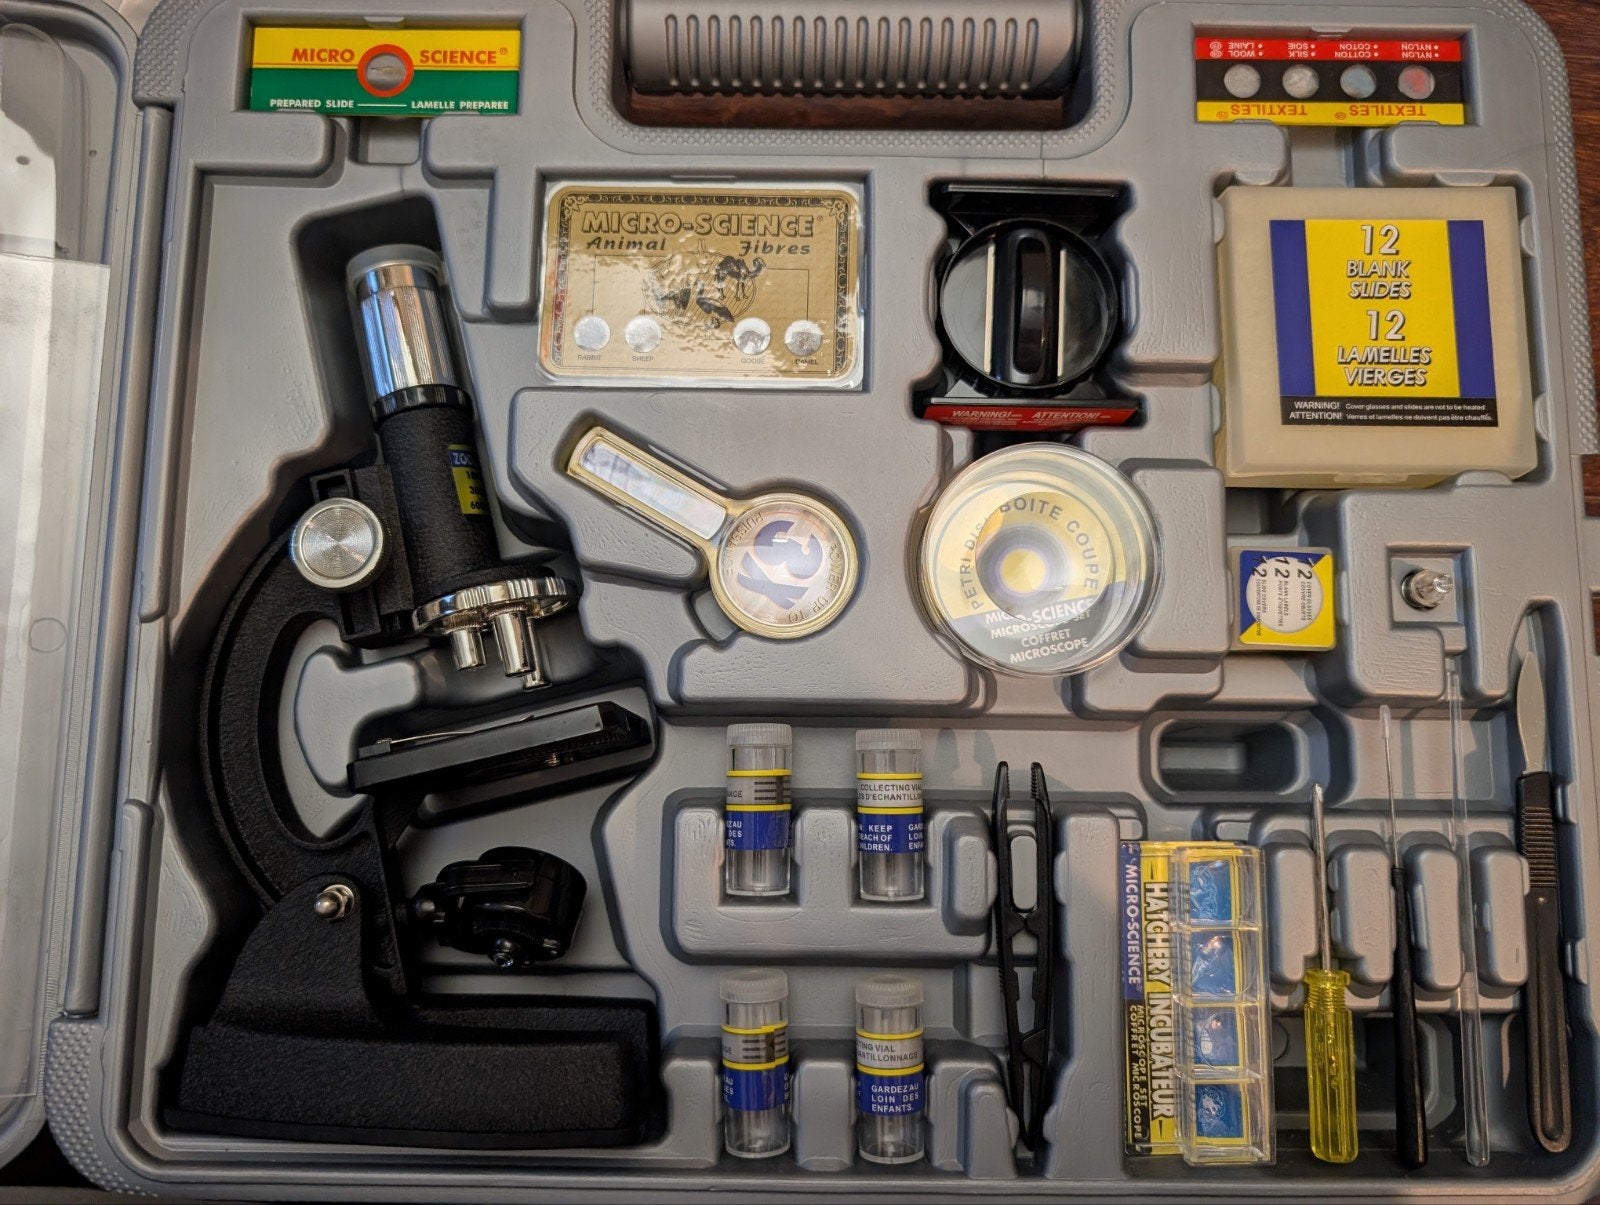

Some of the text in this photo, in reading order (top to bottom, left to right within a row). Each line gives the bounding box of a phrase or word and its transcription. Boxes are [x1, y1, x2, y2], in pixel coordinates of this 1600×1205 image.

[291, 48, 355, 63] MICRO
[270, 99, 322, 108] PREPARED
[326, 100, 354, 108] SLIDE
[411, 100, 455, 109] LAMELLE
[1230, 104, 1308, 116] TEXTILES
[1349, 104, 1426, 117] TEXTILES
[586, 236, 810, 256] Animal Fibres
[1360, 224, 1400, 256] 12
[1346, 260, 1411, 278] BLANK
[1348, 280, 1412, 300] SLIDES
[1366, 310, 1406, 341] 12
[1336, 346, 1432, 365] LAMELLES
[1344, 368, 1427, 386] VIERGES
[1294, 401, 1340, 409] WARNING!
[1289, 411, 1342, 420] ATTENTION!
[1000, 497, 1099, 590] BOITE COUPE
[826, 543, 842, 592] POWER
[960, 517, 988, 610] PETRI DIS
[813, 595, 829, 613] UP
[1021, 629, 1071, 648] COFFRET
[1009, 637, 1088, 664] MICROSCOPE
[1144, 882, 1175, 1121] HATCHERY INCUBATEUR
[1136, 1004, 1148, 1107] MICROSCOPE SET
[1130, 1005, 1143, 1139] COFFRET MICROSCOPE
[871, 1084, 908, 1093] GARDEZ
[871, 1092, 919, 1103] LOIN DES
